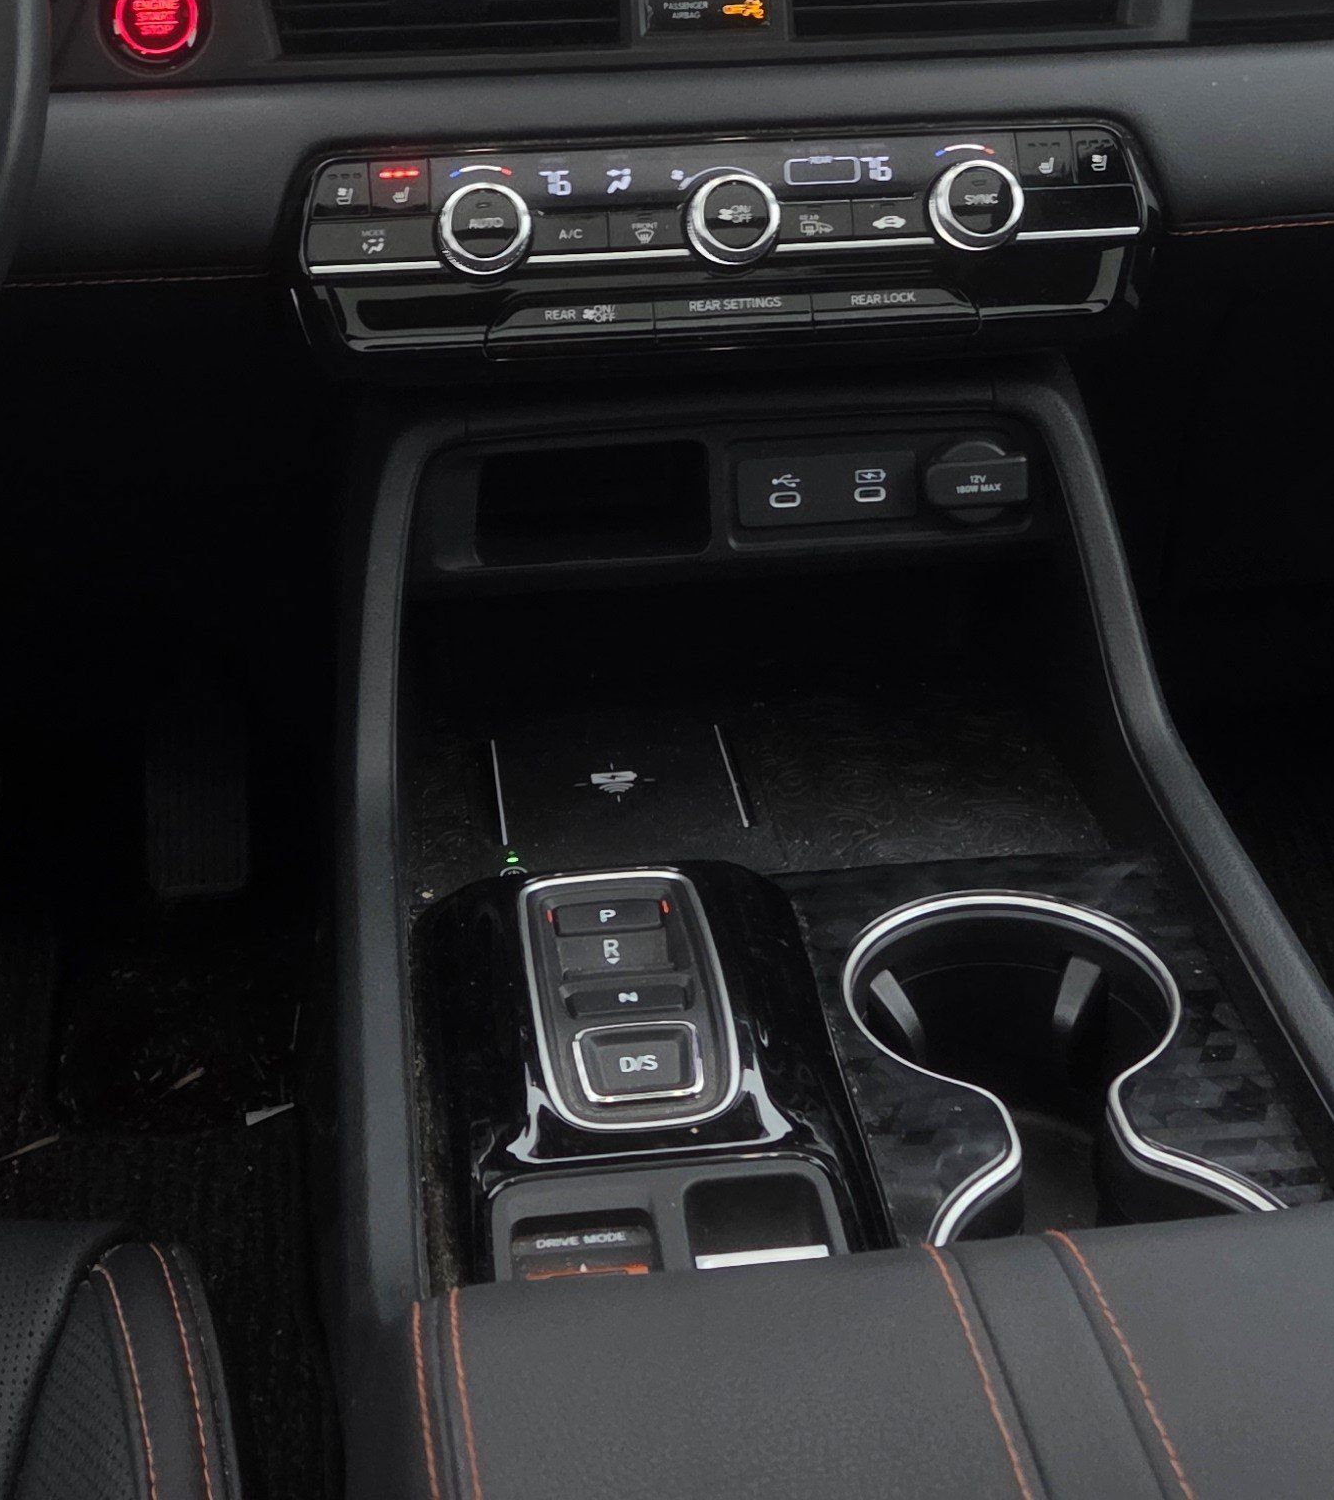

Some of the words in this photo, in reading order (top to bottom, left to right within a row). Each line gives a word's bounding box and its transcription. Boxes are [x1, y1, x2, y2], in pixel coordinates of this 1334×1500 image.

[663, 1, 709, 11] PASSENGER
[672, 11, 701, 20] AIRBAG
[140, 24, 175, 36] STOP
[964, 193, 999, 206] SYNC
[468, 217, 504, 229] AUTO
[731, 213, 753, 224] OFF
[632, 221, 658, 230] FRONT
[559, 229, 583, 240] A/C
[688, 299, 721, 312] REAR
[723, 296, 782, 310] SETTINGS
[851, 294, 881, 306] REAR
[883, 292, 916, 304] LOCK
[545, 309, 576, 321] REAR
[594, 312, 616, 323] OFF
[970, 475, 987, 484] 12V
[980, 483, 1002, 492] MAX
[599, 909, 617, 923] P
[603, 939, 620, 958] R
[619, 1054, 659, 1073] D/S
[536, 1236, 580, 1249] DRIVE
[583, 1232, 627, 1244] MODE
